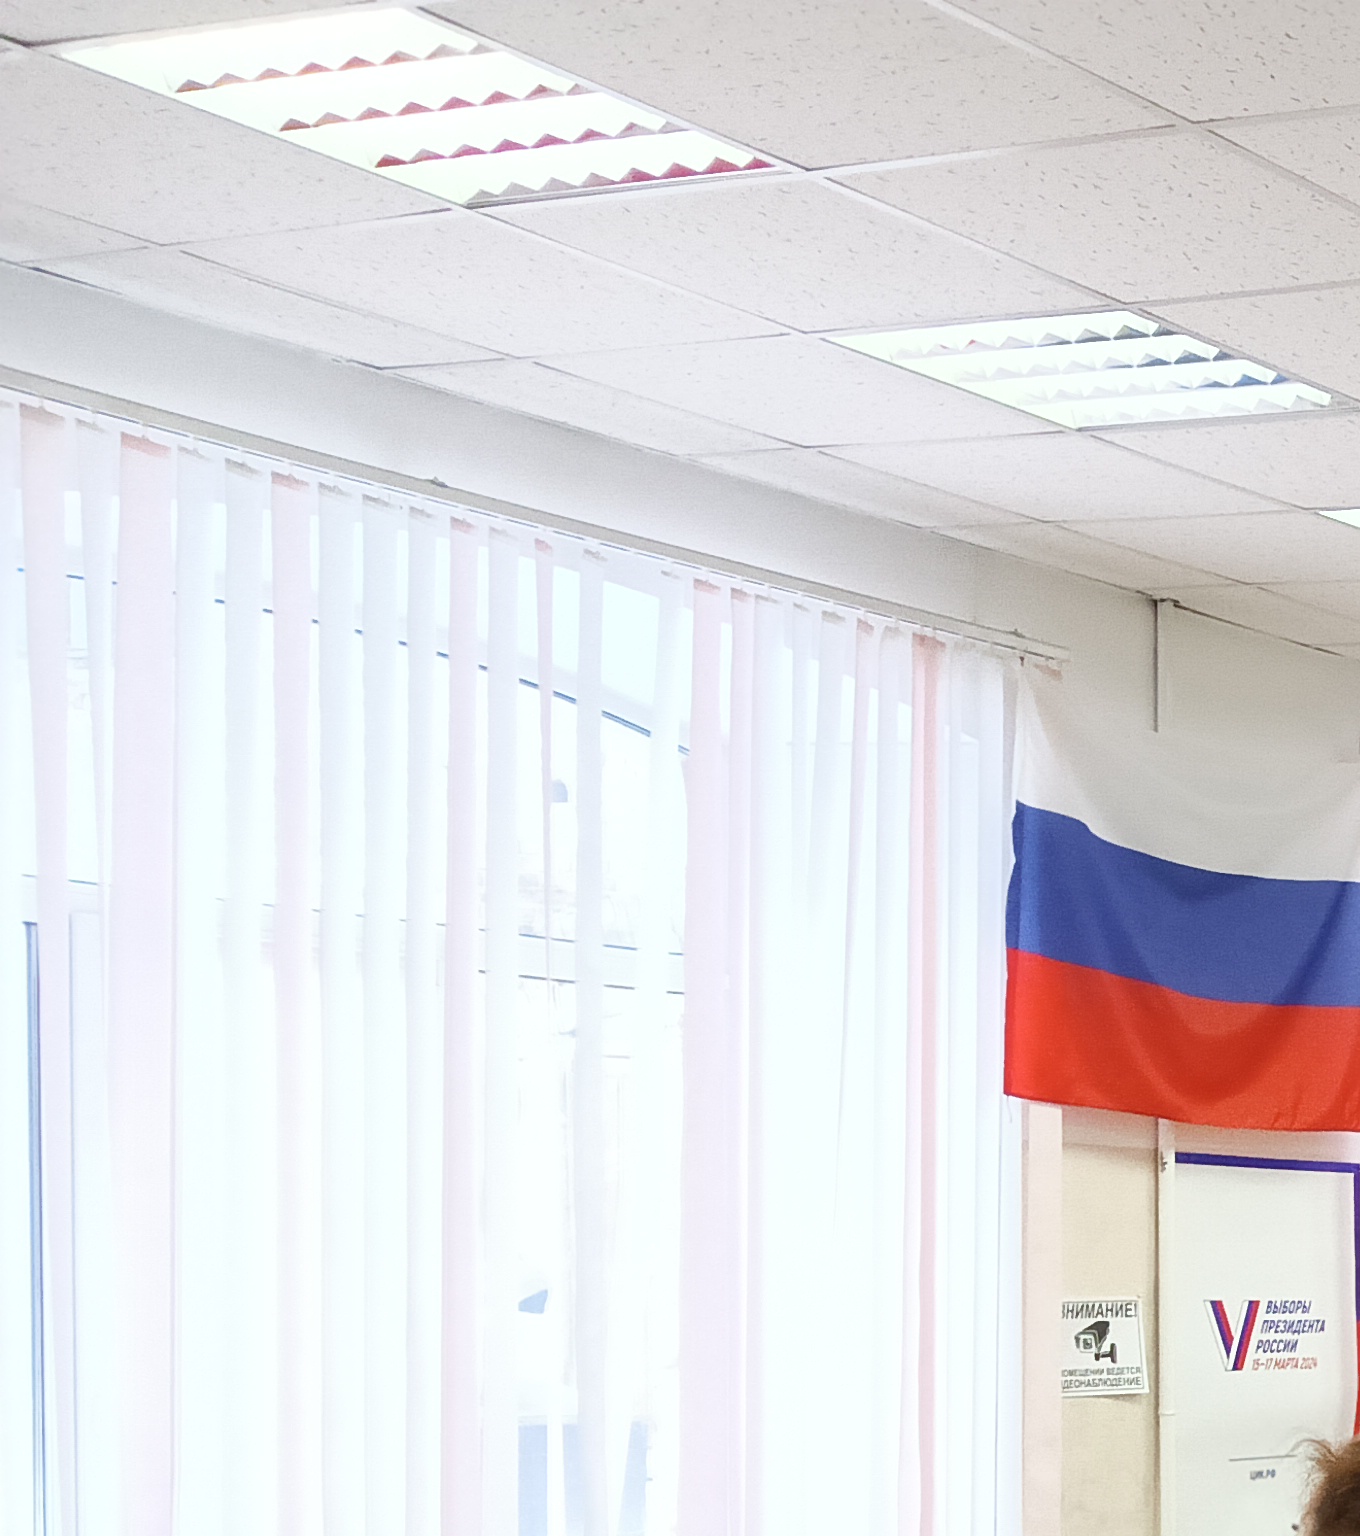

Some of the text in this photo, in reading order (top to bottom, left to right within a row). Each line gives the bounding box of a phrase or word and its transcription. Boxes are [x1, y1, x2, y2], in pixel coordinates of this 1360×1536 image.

[1265, 1300, 1312, 1315] ВЫБОРЫ
[1260, 1319, 1326, 1335] ПРЕЗИДЕНТА
[1255, 1339, 1299, 1354] РОССИИ
[1061, 1377, 1142, 1390] ДЕОНАБЛЮДЕНИЕ
